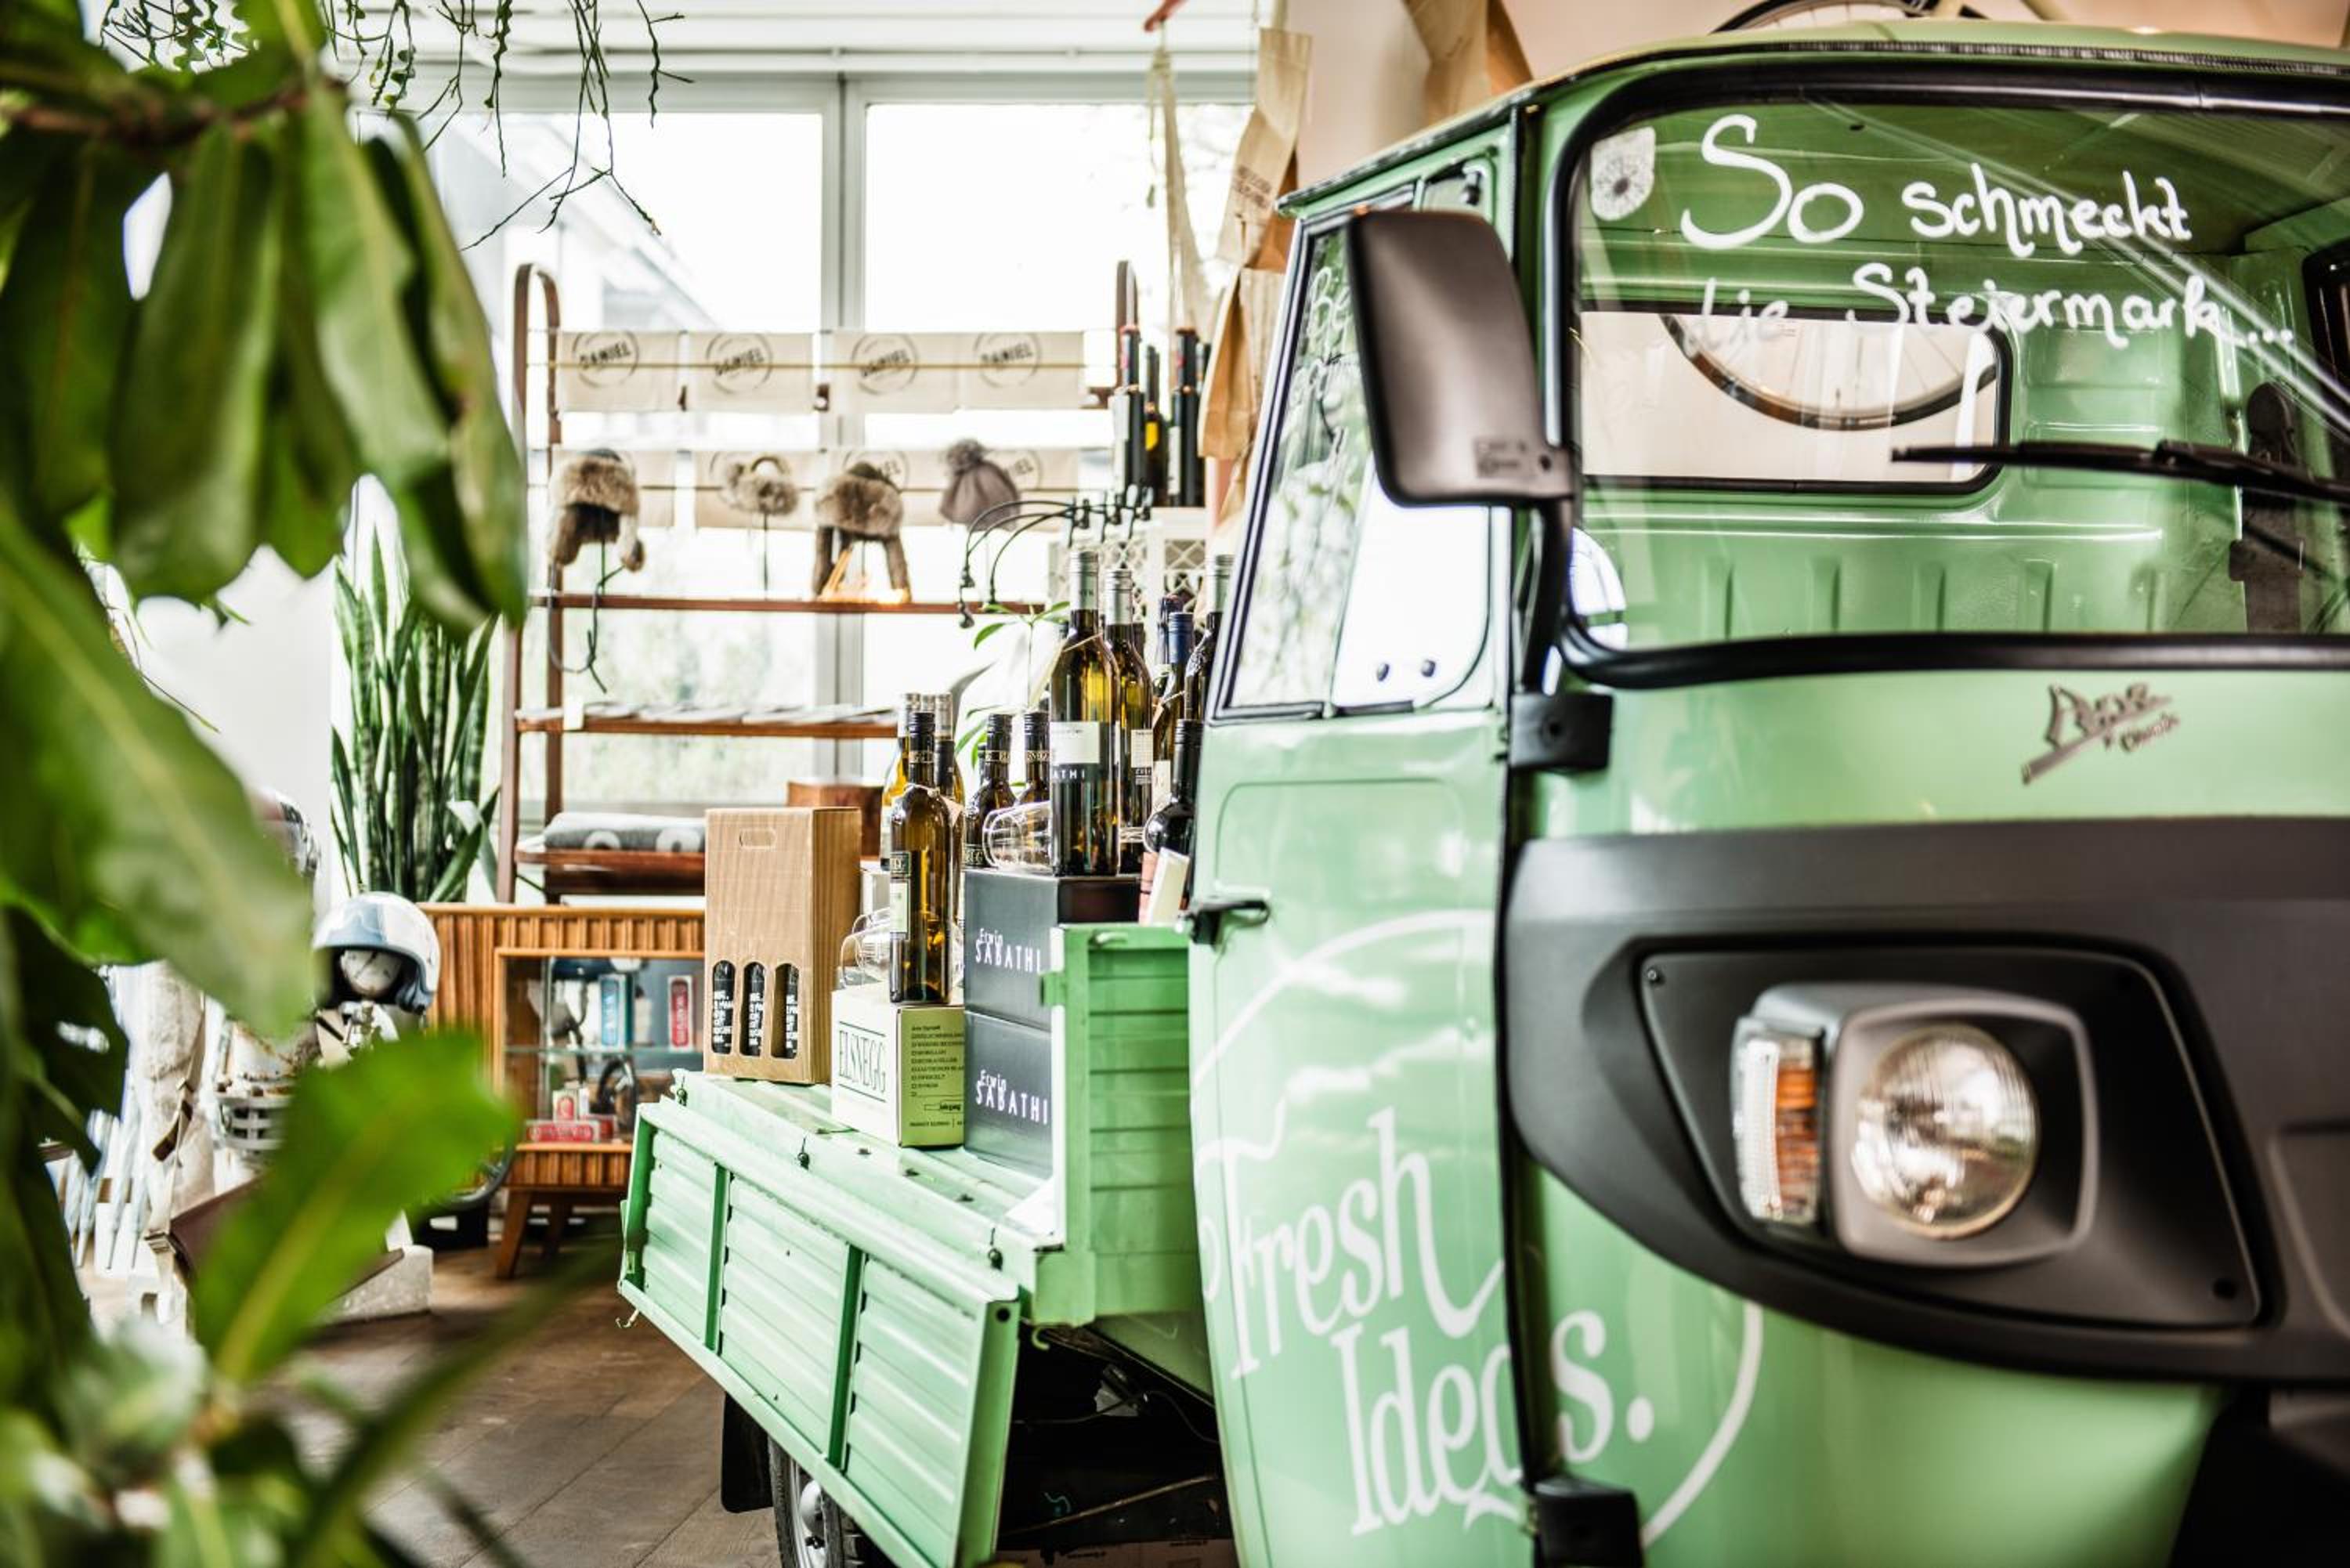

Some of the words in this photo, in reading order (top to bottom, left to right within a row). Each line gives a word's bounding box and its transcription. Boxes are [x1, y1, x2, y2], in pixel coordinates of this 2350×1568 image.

[1681, 114, 1864, 251] So
[1901, 162, 2193, 258] schmeckt
[975, 939, 1041, 974] SABATHI
[975, 1080, 1049, 1125] SABATHI
[1197, 1099, 1503, 1380] Fresh
